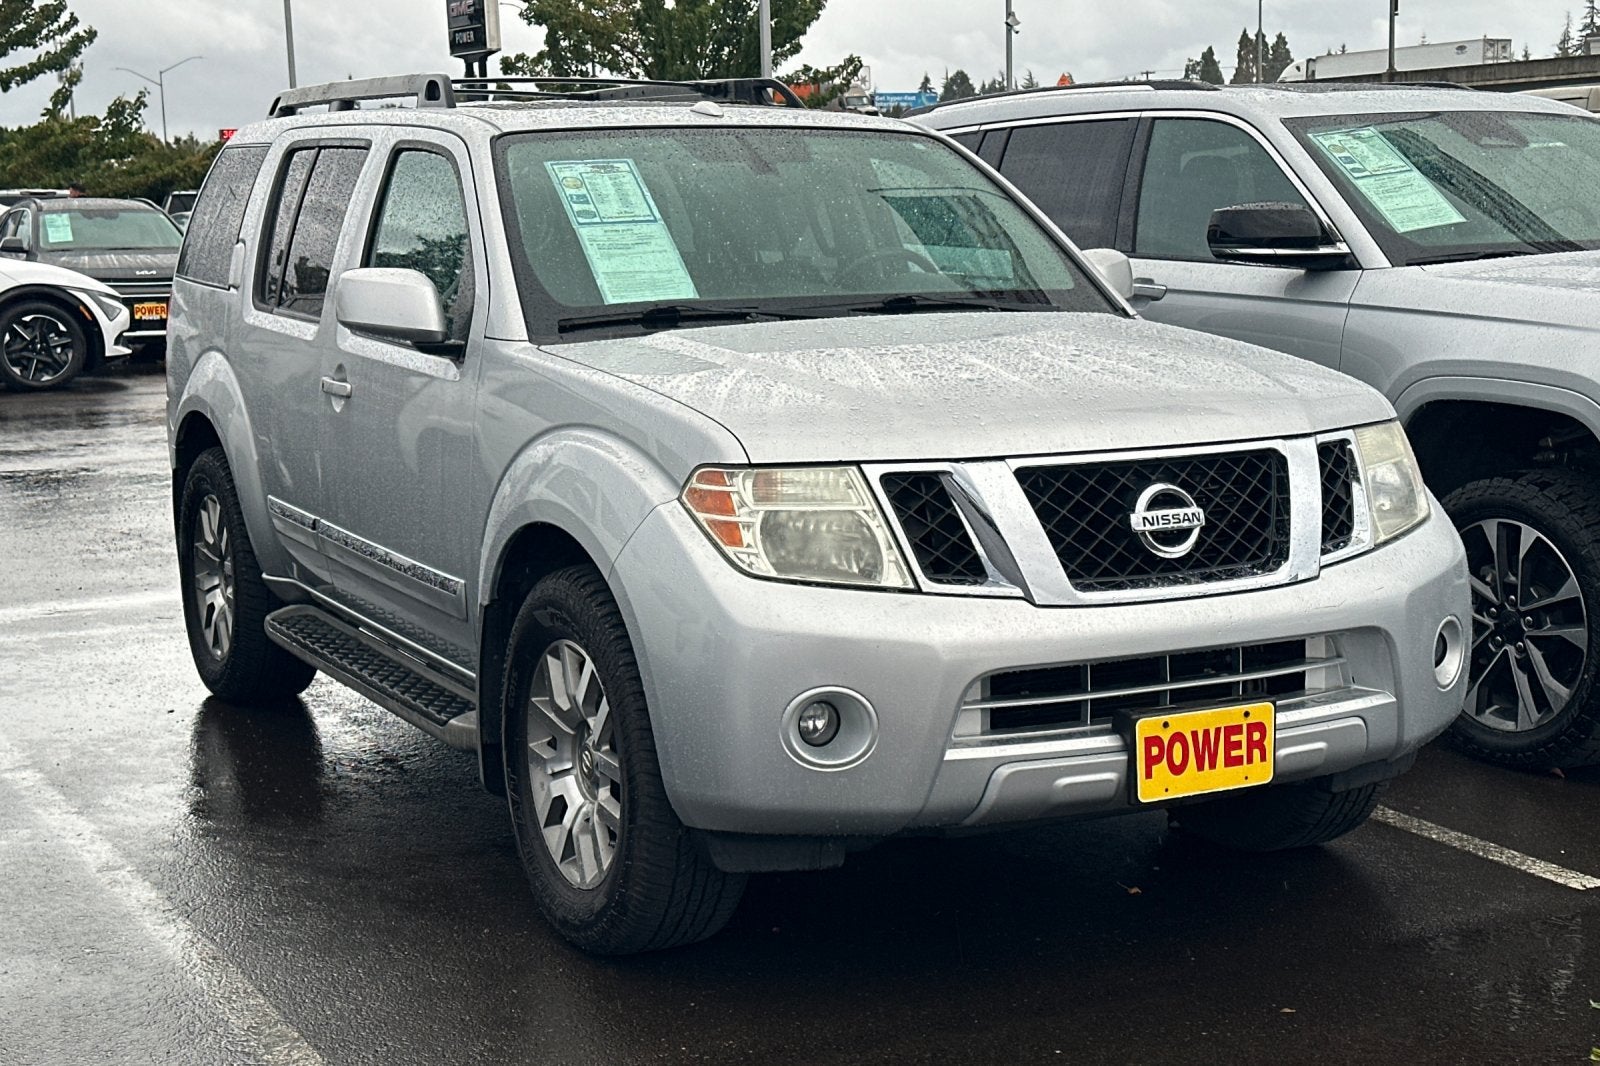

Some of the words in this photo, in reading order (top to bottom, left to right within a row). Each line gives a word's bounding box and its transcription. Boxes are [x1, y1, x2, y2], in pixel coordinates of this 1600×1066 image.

[450, 0, 475, 16] GMC
[455, 31, 474, 44] POWER
[136, 306, 166, 315] POWER
[1142, 511, 1202, 527] NISSAN
[1143, 721, 1268, 780] POWER
